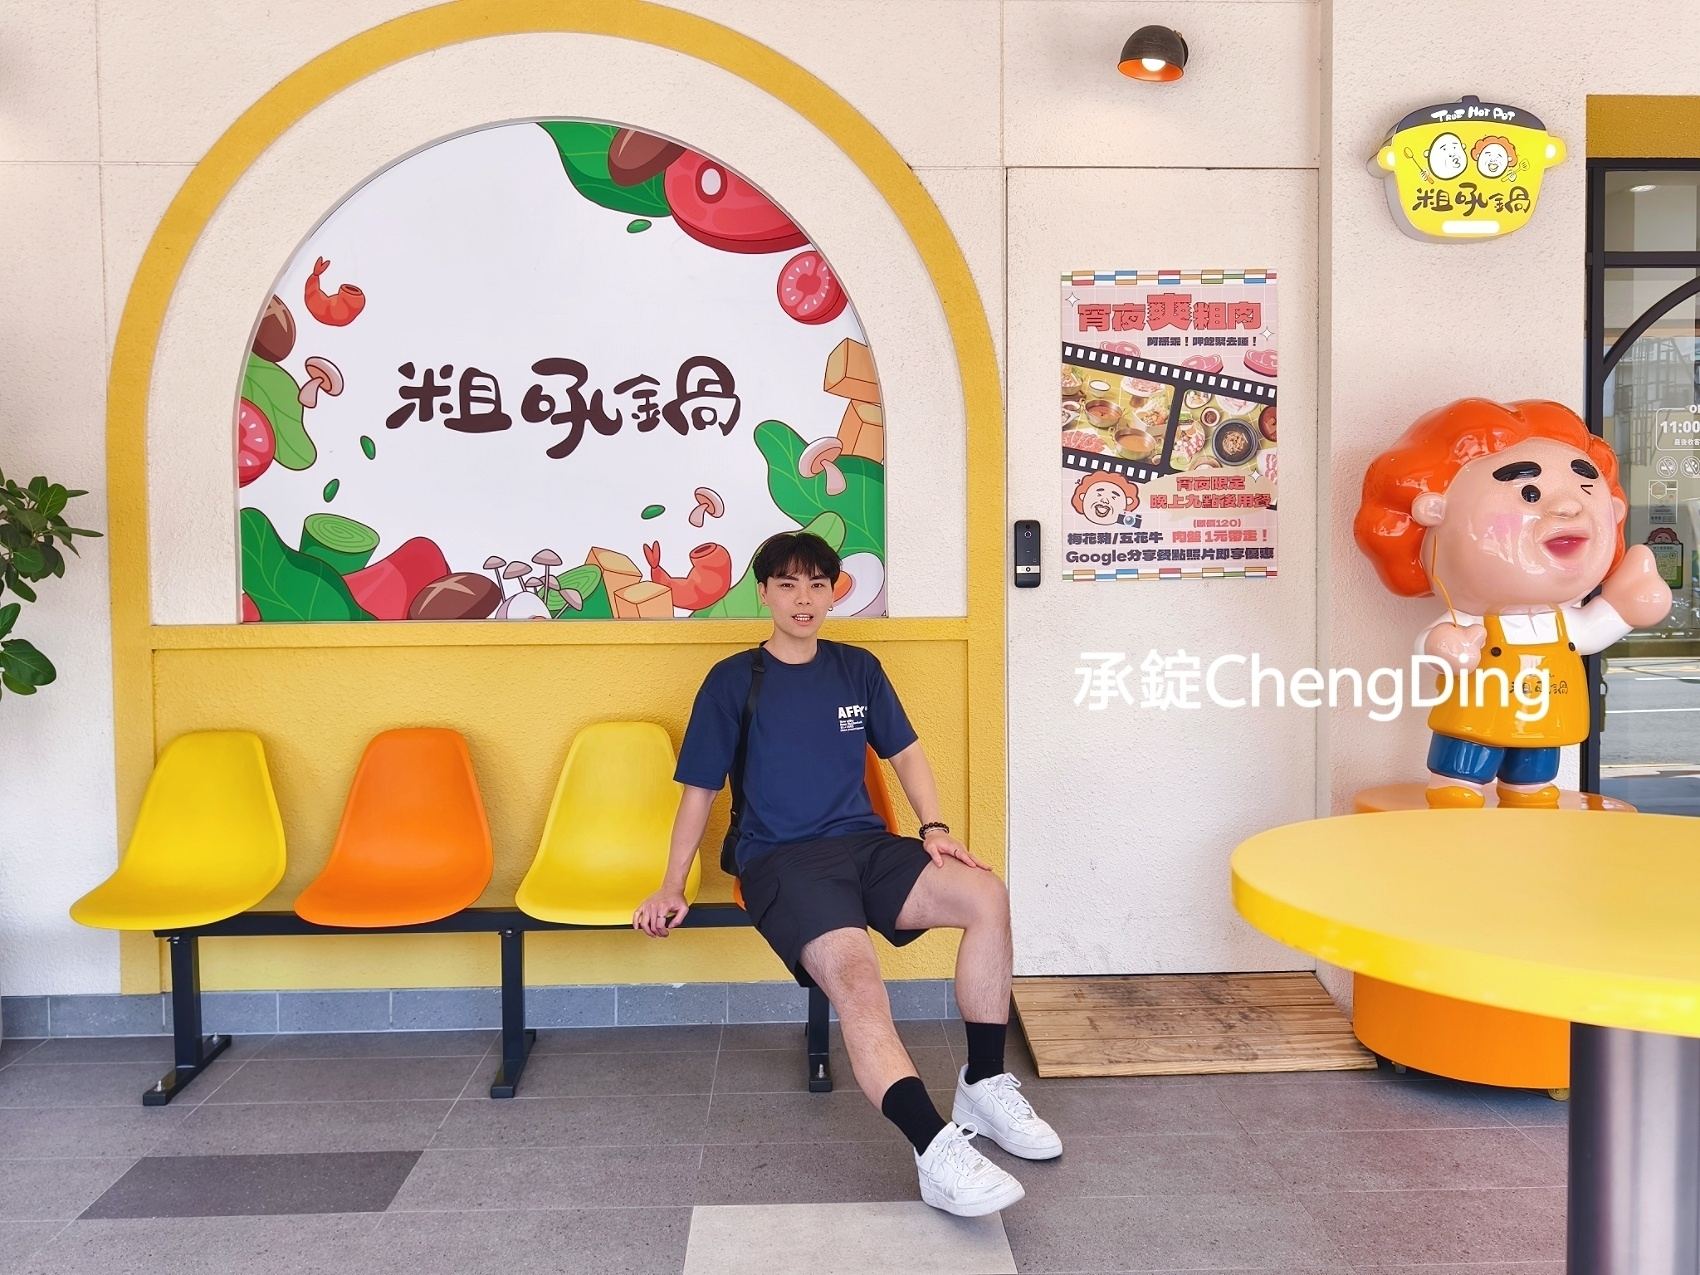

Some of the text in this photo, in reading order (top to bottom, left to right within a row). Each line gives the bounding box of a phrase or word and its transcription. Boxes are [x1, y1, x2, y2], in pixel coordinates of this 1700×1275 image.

[1412, 182, 1531, 217] 粗吼鍋
[1077, 293, 1262, 332] 宵夜爽粗肉
[386, 356, 741, 459] 粗吼鍋
[1176, 476, 1246, 492] 宵夜限定
[1150, 494, 1272, 509] 晚上九點後用餐
[1067, 532, 1164, 546] 梅花豬/五花牛
[1065, 547, 1275, 566] Google分享餐點照片即享優惠
